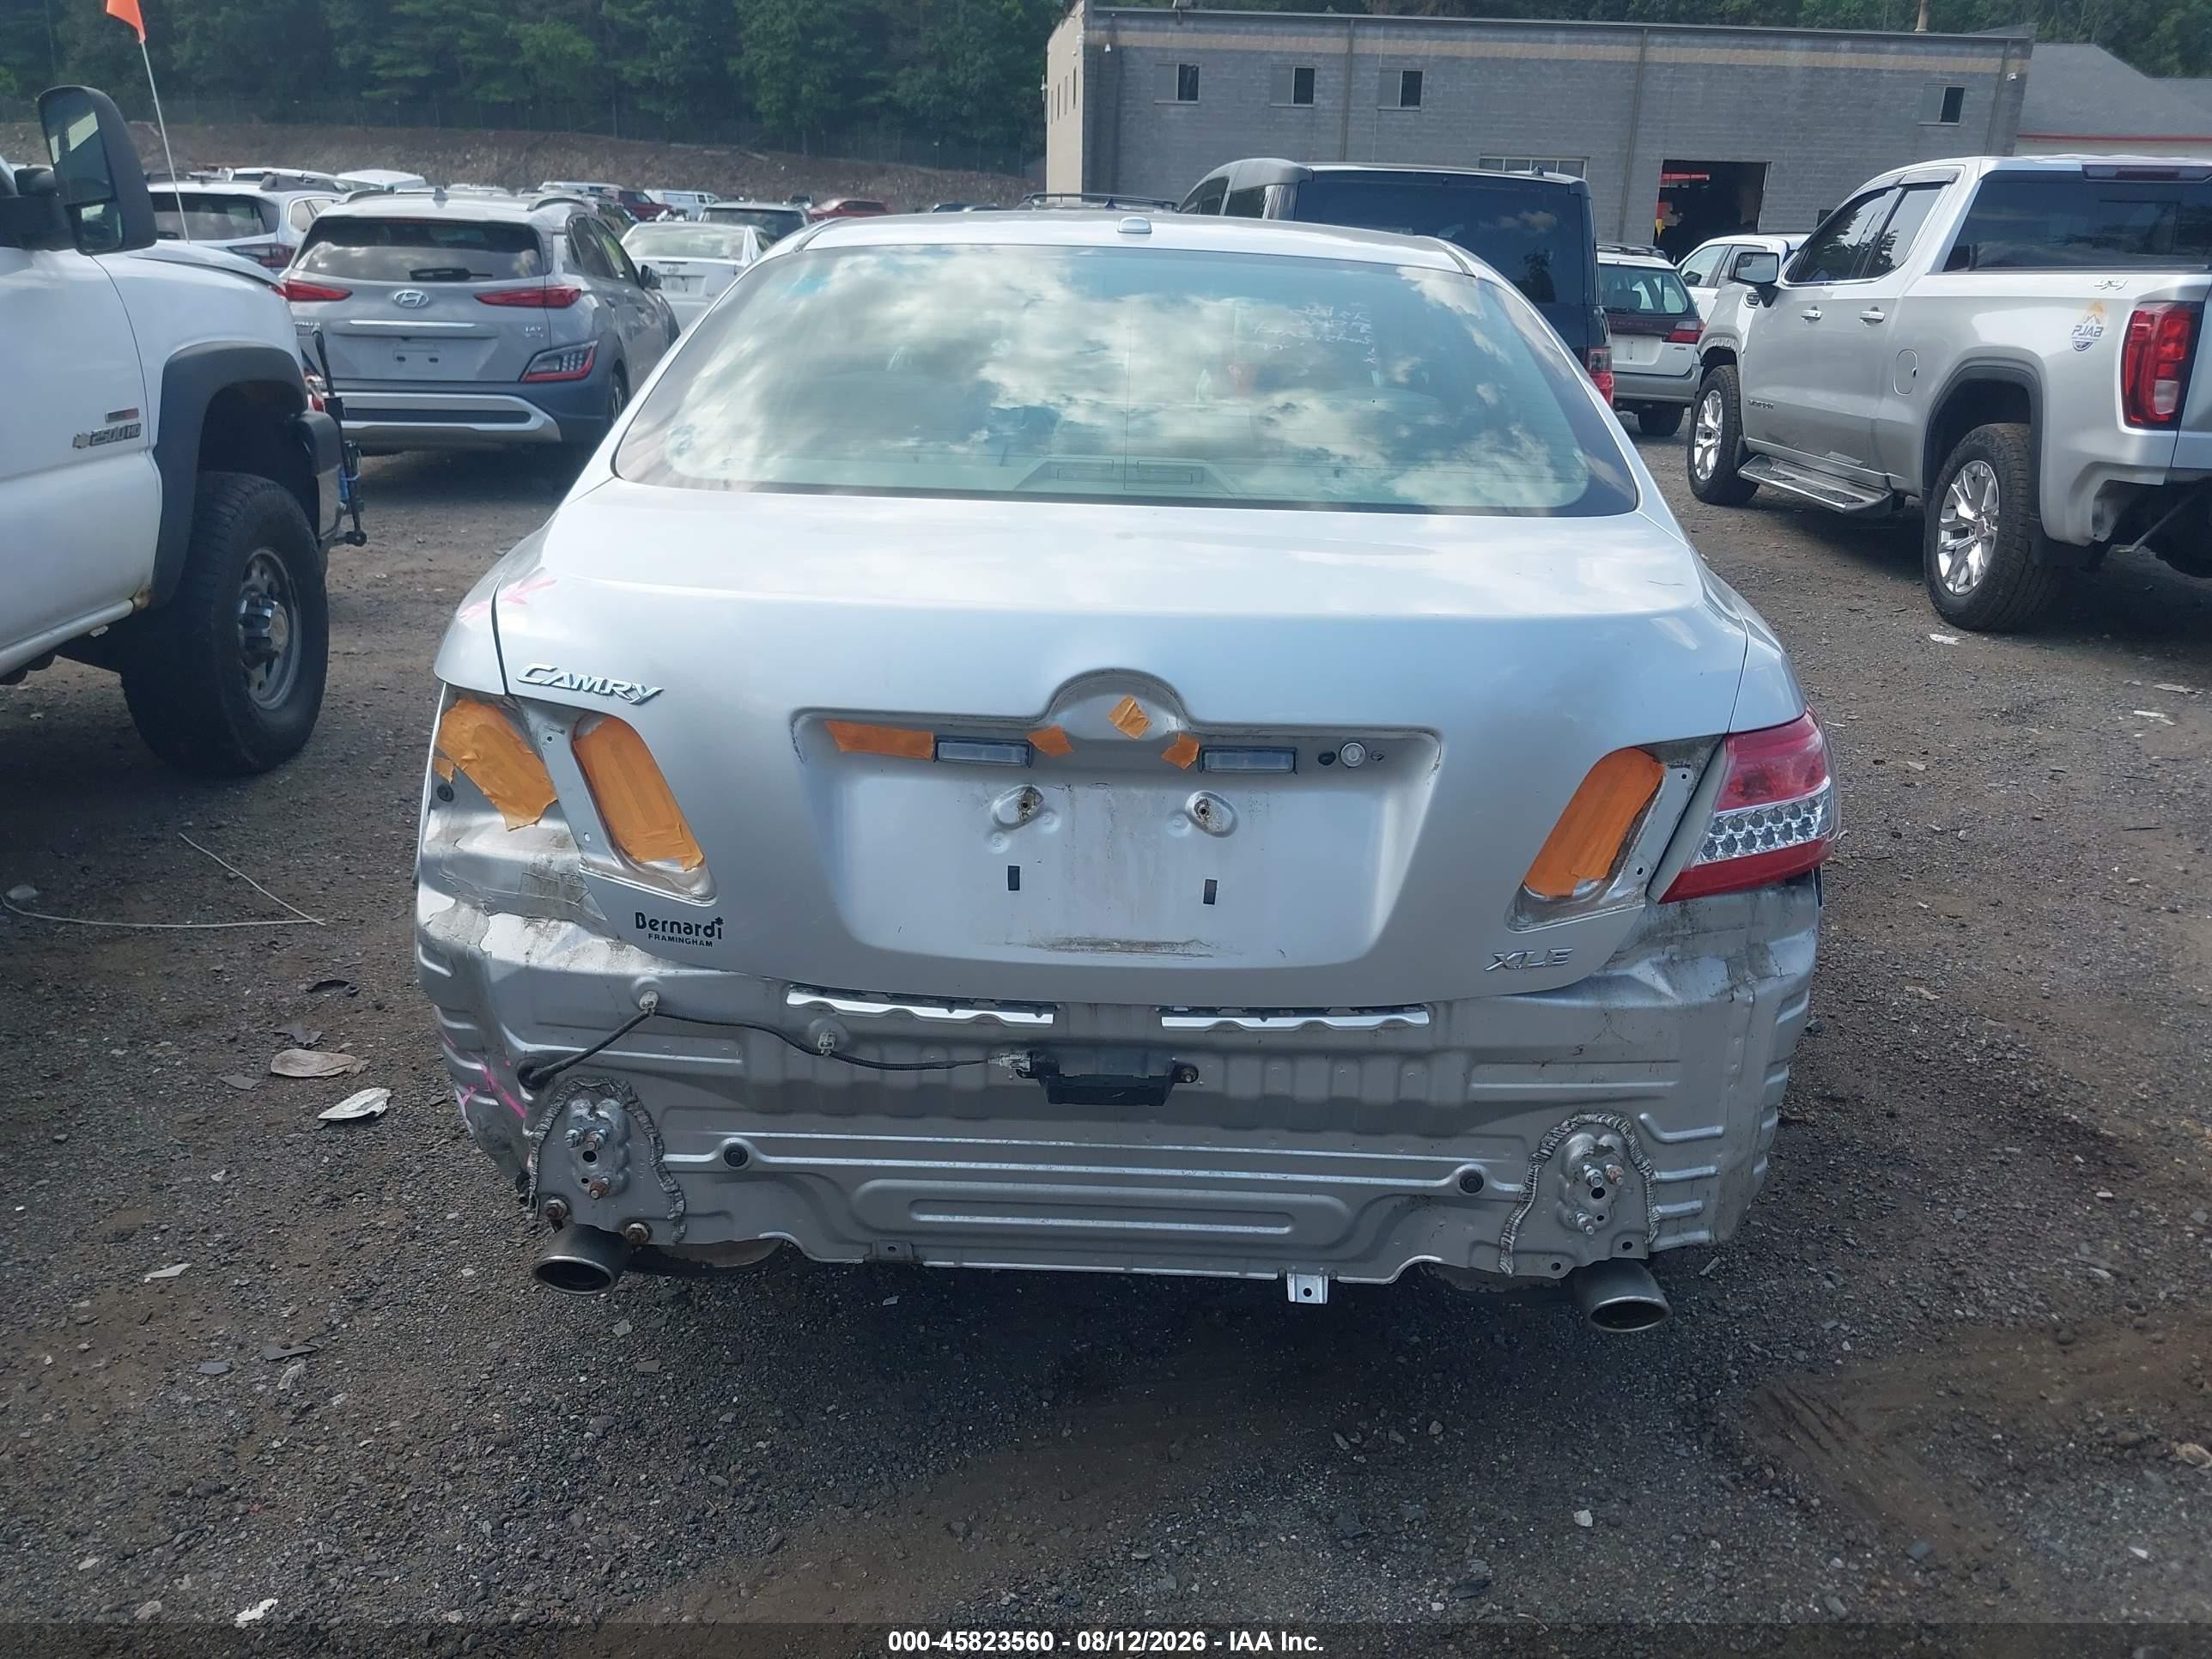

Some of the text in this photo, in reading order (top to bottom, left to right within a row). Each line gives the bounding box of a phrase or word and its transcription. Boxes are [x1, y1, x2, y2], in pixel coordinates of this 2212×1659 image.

[635, 912, 724, 939] Bernardi
[647, 933, 713, 947] FRAMINGHAM
[1484, 948, 1573, 971] XLE
